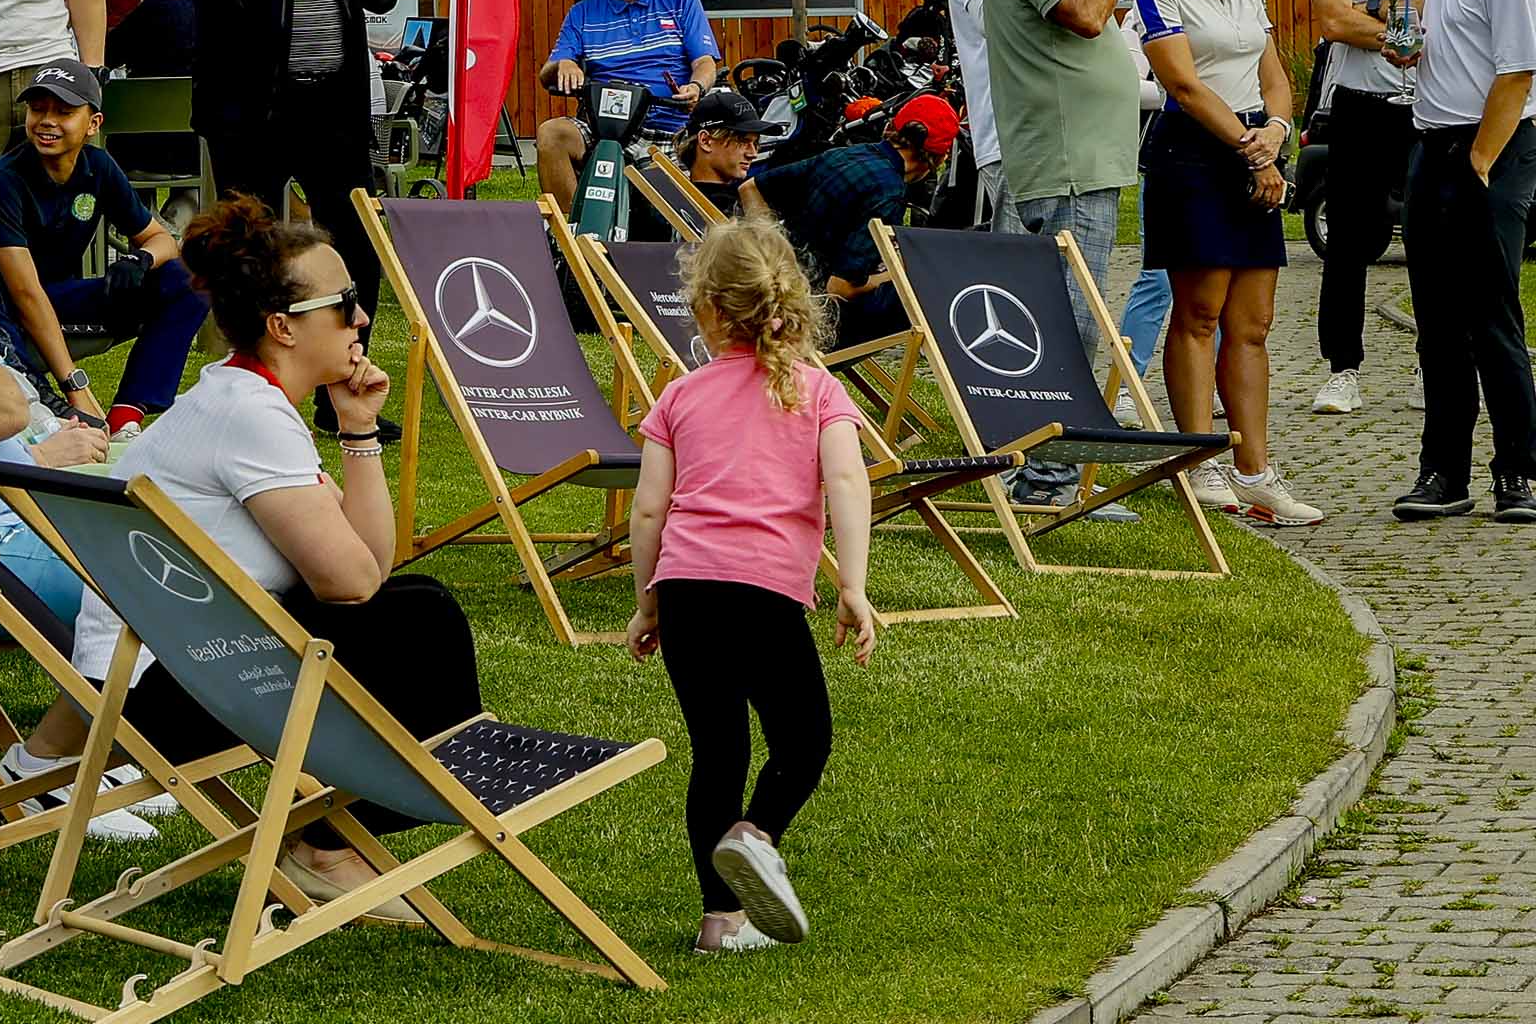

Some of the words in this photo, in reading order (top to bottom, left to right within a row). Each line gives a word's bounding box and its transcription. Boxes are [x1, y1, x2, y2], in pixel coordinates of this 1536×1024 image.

[587, 188, 614, 200] GOLF
[460, 386, 528, 399] INTER-CAR
[529, 385, 572, 399] SILESIA
[966, 385, 1030, 400] INTER-CAR
[1029, 390, 1074, 401] RYBNIK
[471, 407, 539, 422] INTER-CAR
[539, 407, 585, 422] RYBNIK
